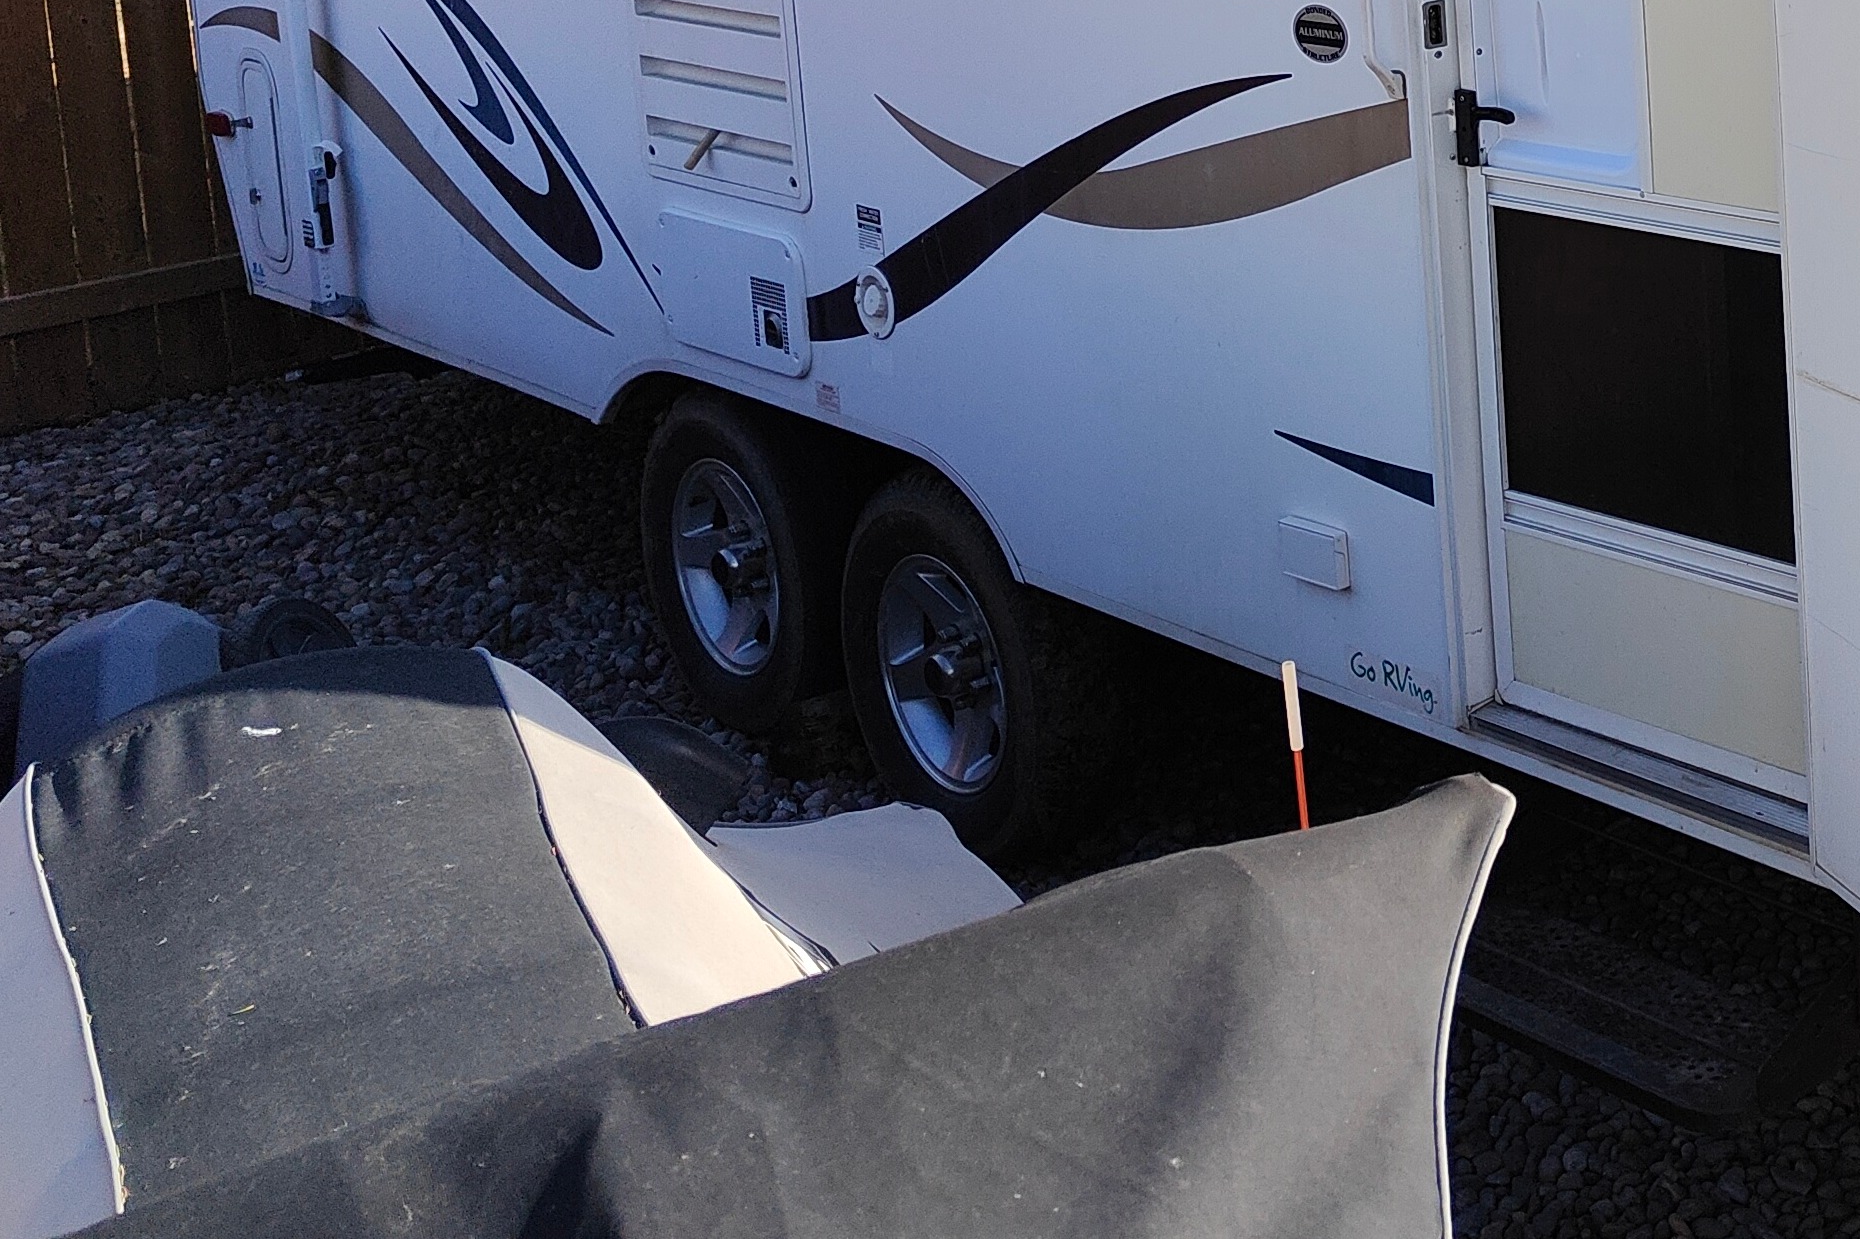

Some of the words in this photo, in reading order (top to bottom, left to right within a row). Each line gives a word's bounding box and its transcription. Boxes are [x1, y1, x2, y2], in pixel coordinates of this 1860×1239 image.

[1298, 26, 1343, 41] ALUMINUM
[1302, 46, 1342, 62] STRUCTURE
[1350, 651, 1376, 682] Go
